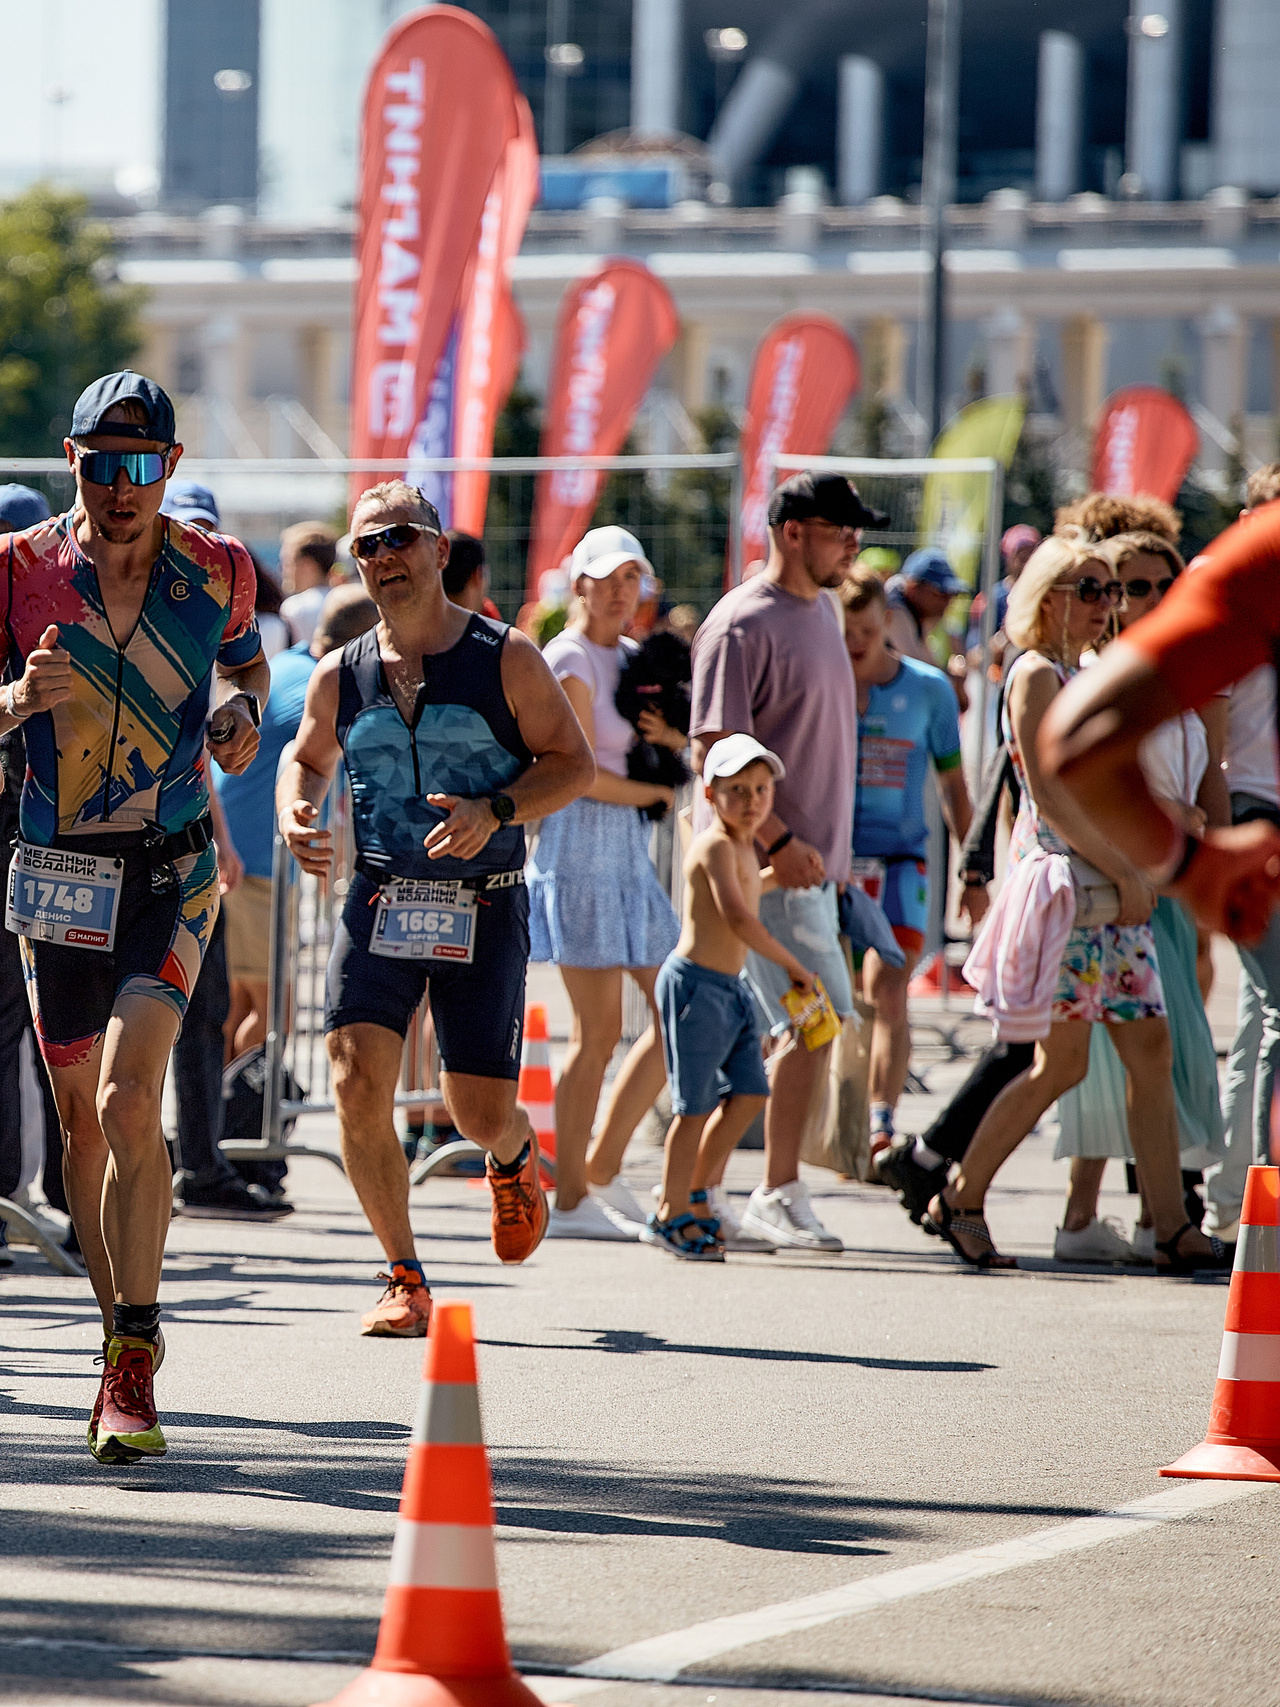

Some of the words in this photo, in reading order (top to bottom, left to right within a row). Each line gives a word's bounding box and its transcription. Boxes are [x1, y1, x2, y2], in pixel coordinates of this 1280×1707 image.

[23, 857, 96, 876] ВСАДНИК
[24, 847, 97, 867] МЕДНЫЙ
[23, 880, 94, 913] 1748
[35, 909, 72, 922] ДЕНИС
[397, 910, 455, 934] 1662
[77, 933, 105, 942] МАГНИТ
